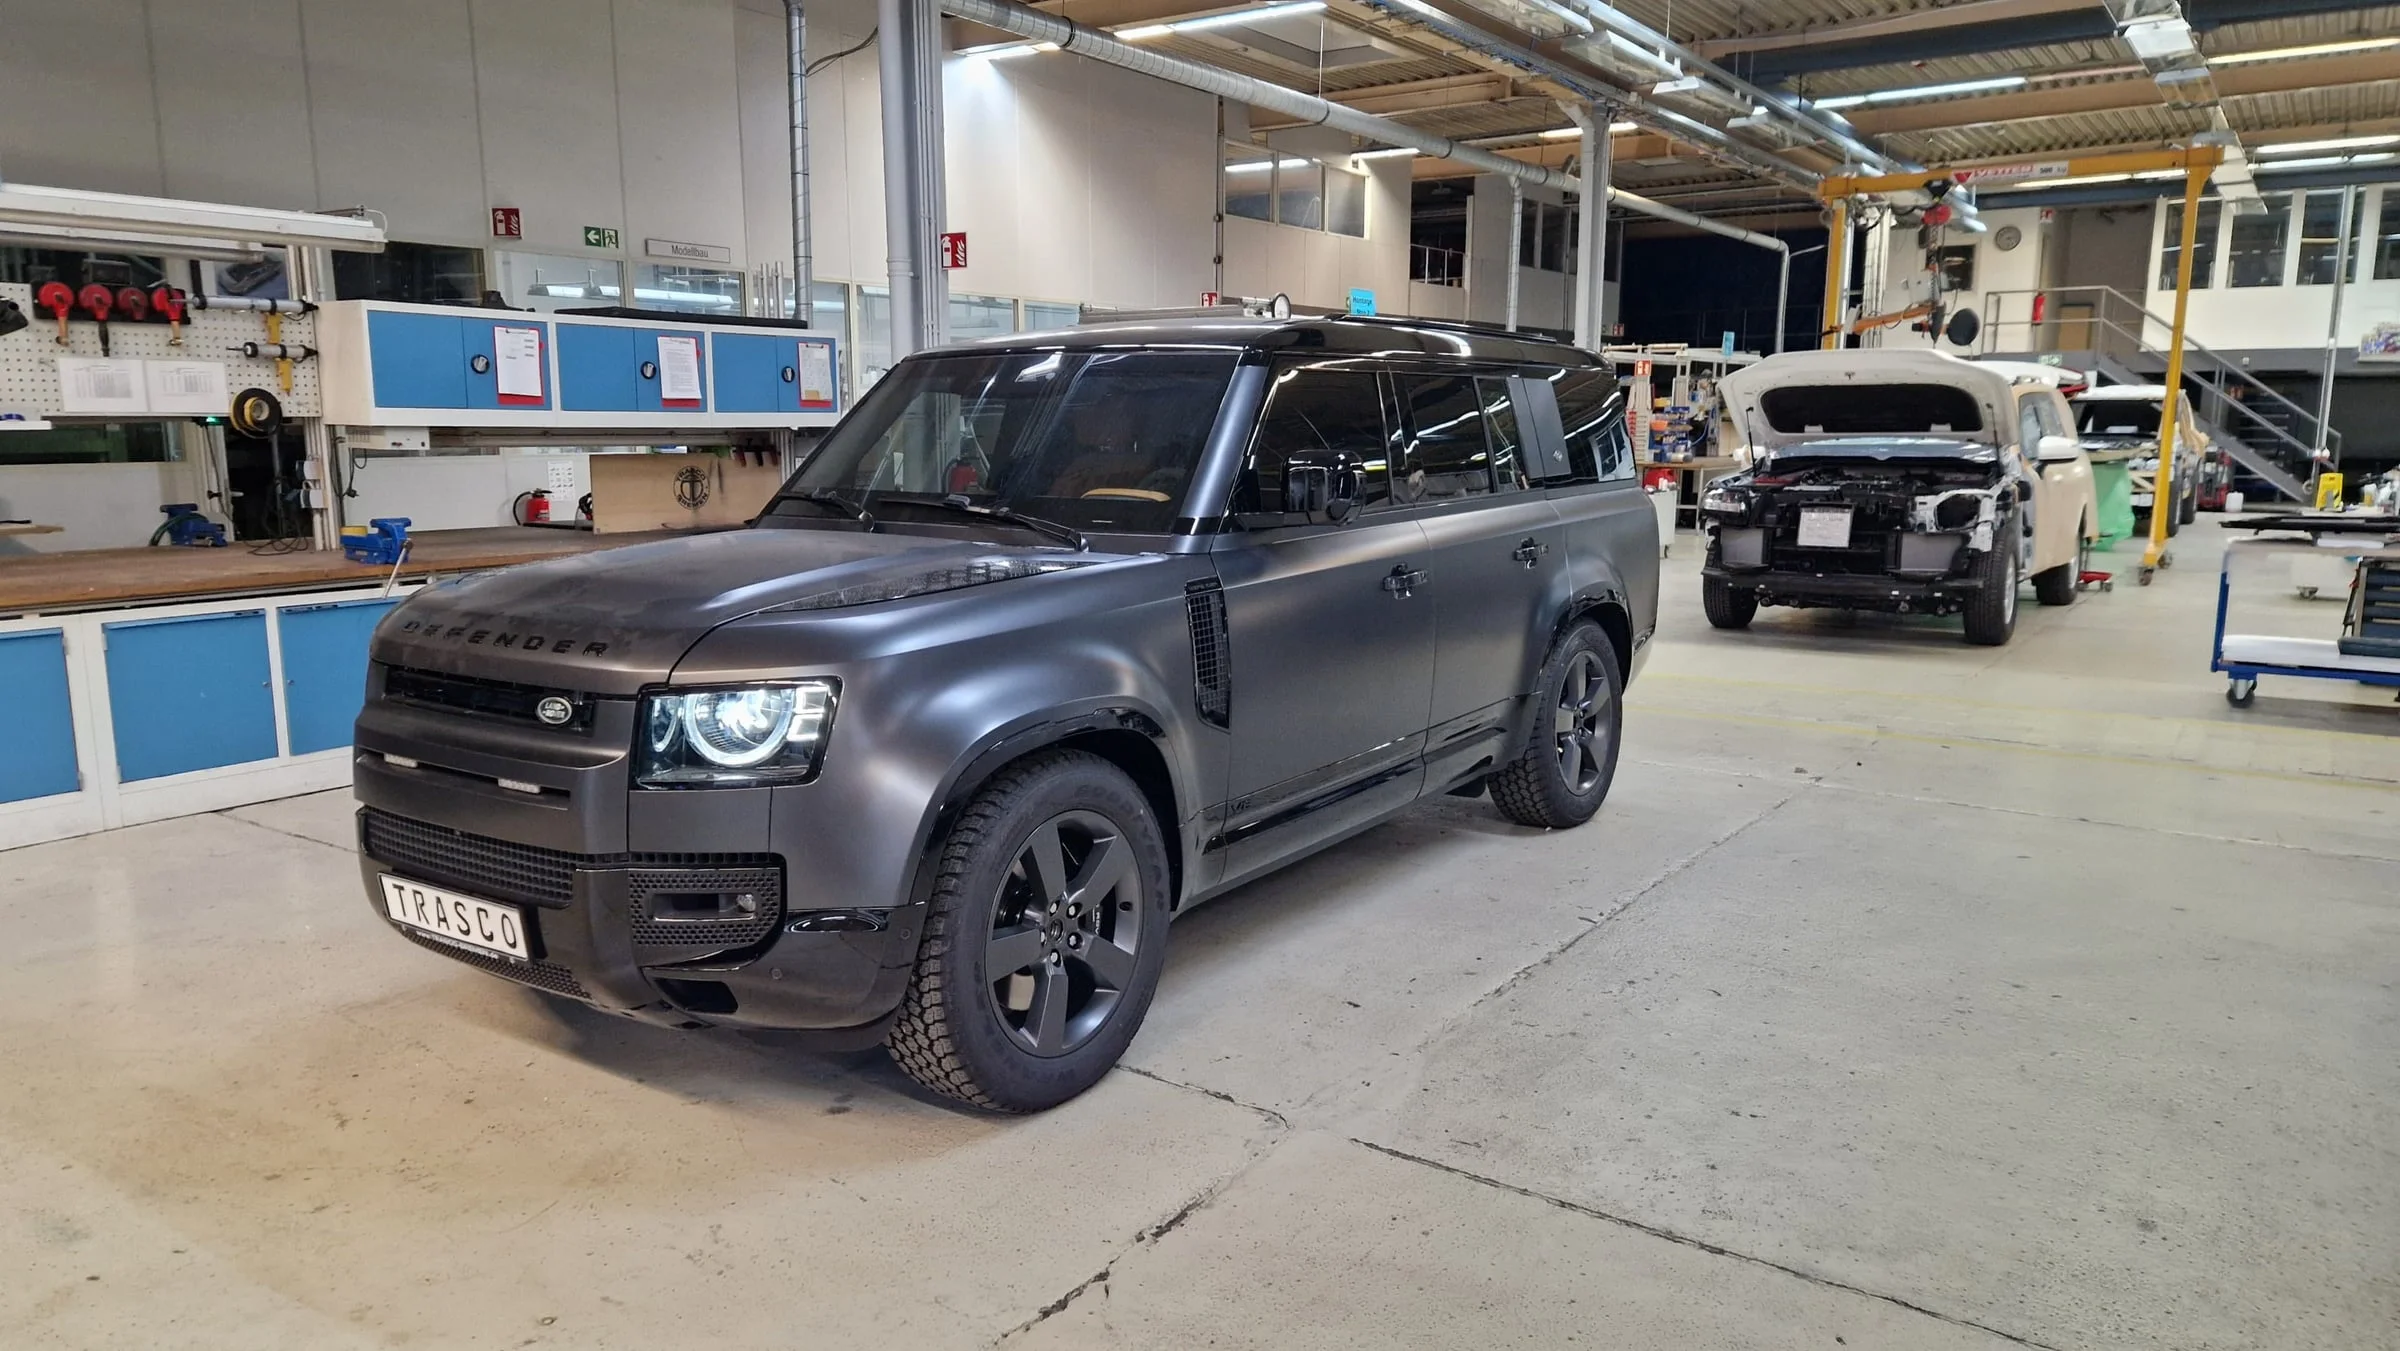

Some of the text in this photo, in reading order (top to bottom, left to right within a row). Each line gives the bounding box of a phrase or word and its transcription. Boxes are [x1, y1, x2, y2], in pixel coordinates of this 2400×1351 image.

[671, 244, 709, 258] Modellbau
[676, 467, 706, 482] TRASCO
[677, 493, 708, 508] BREMEN
[401, 620, 609, 656] DEFENDER
[392, 883, 517, 949] TRASCO
